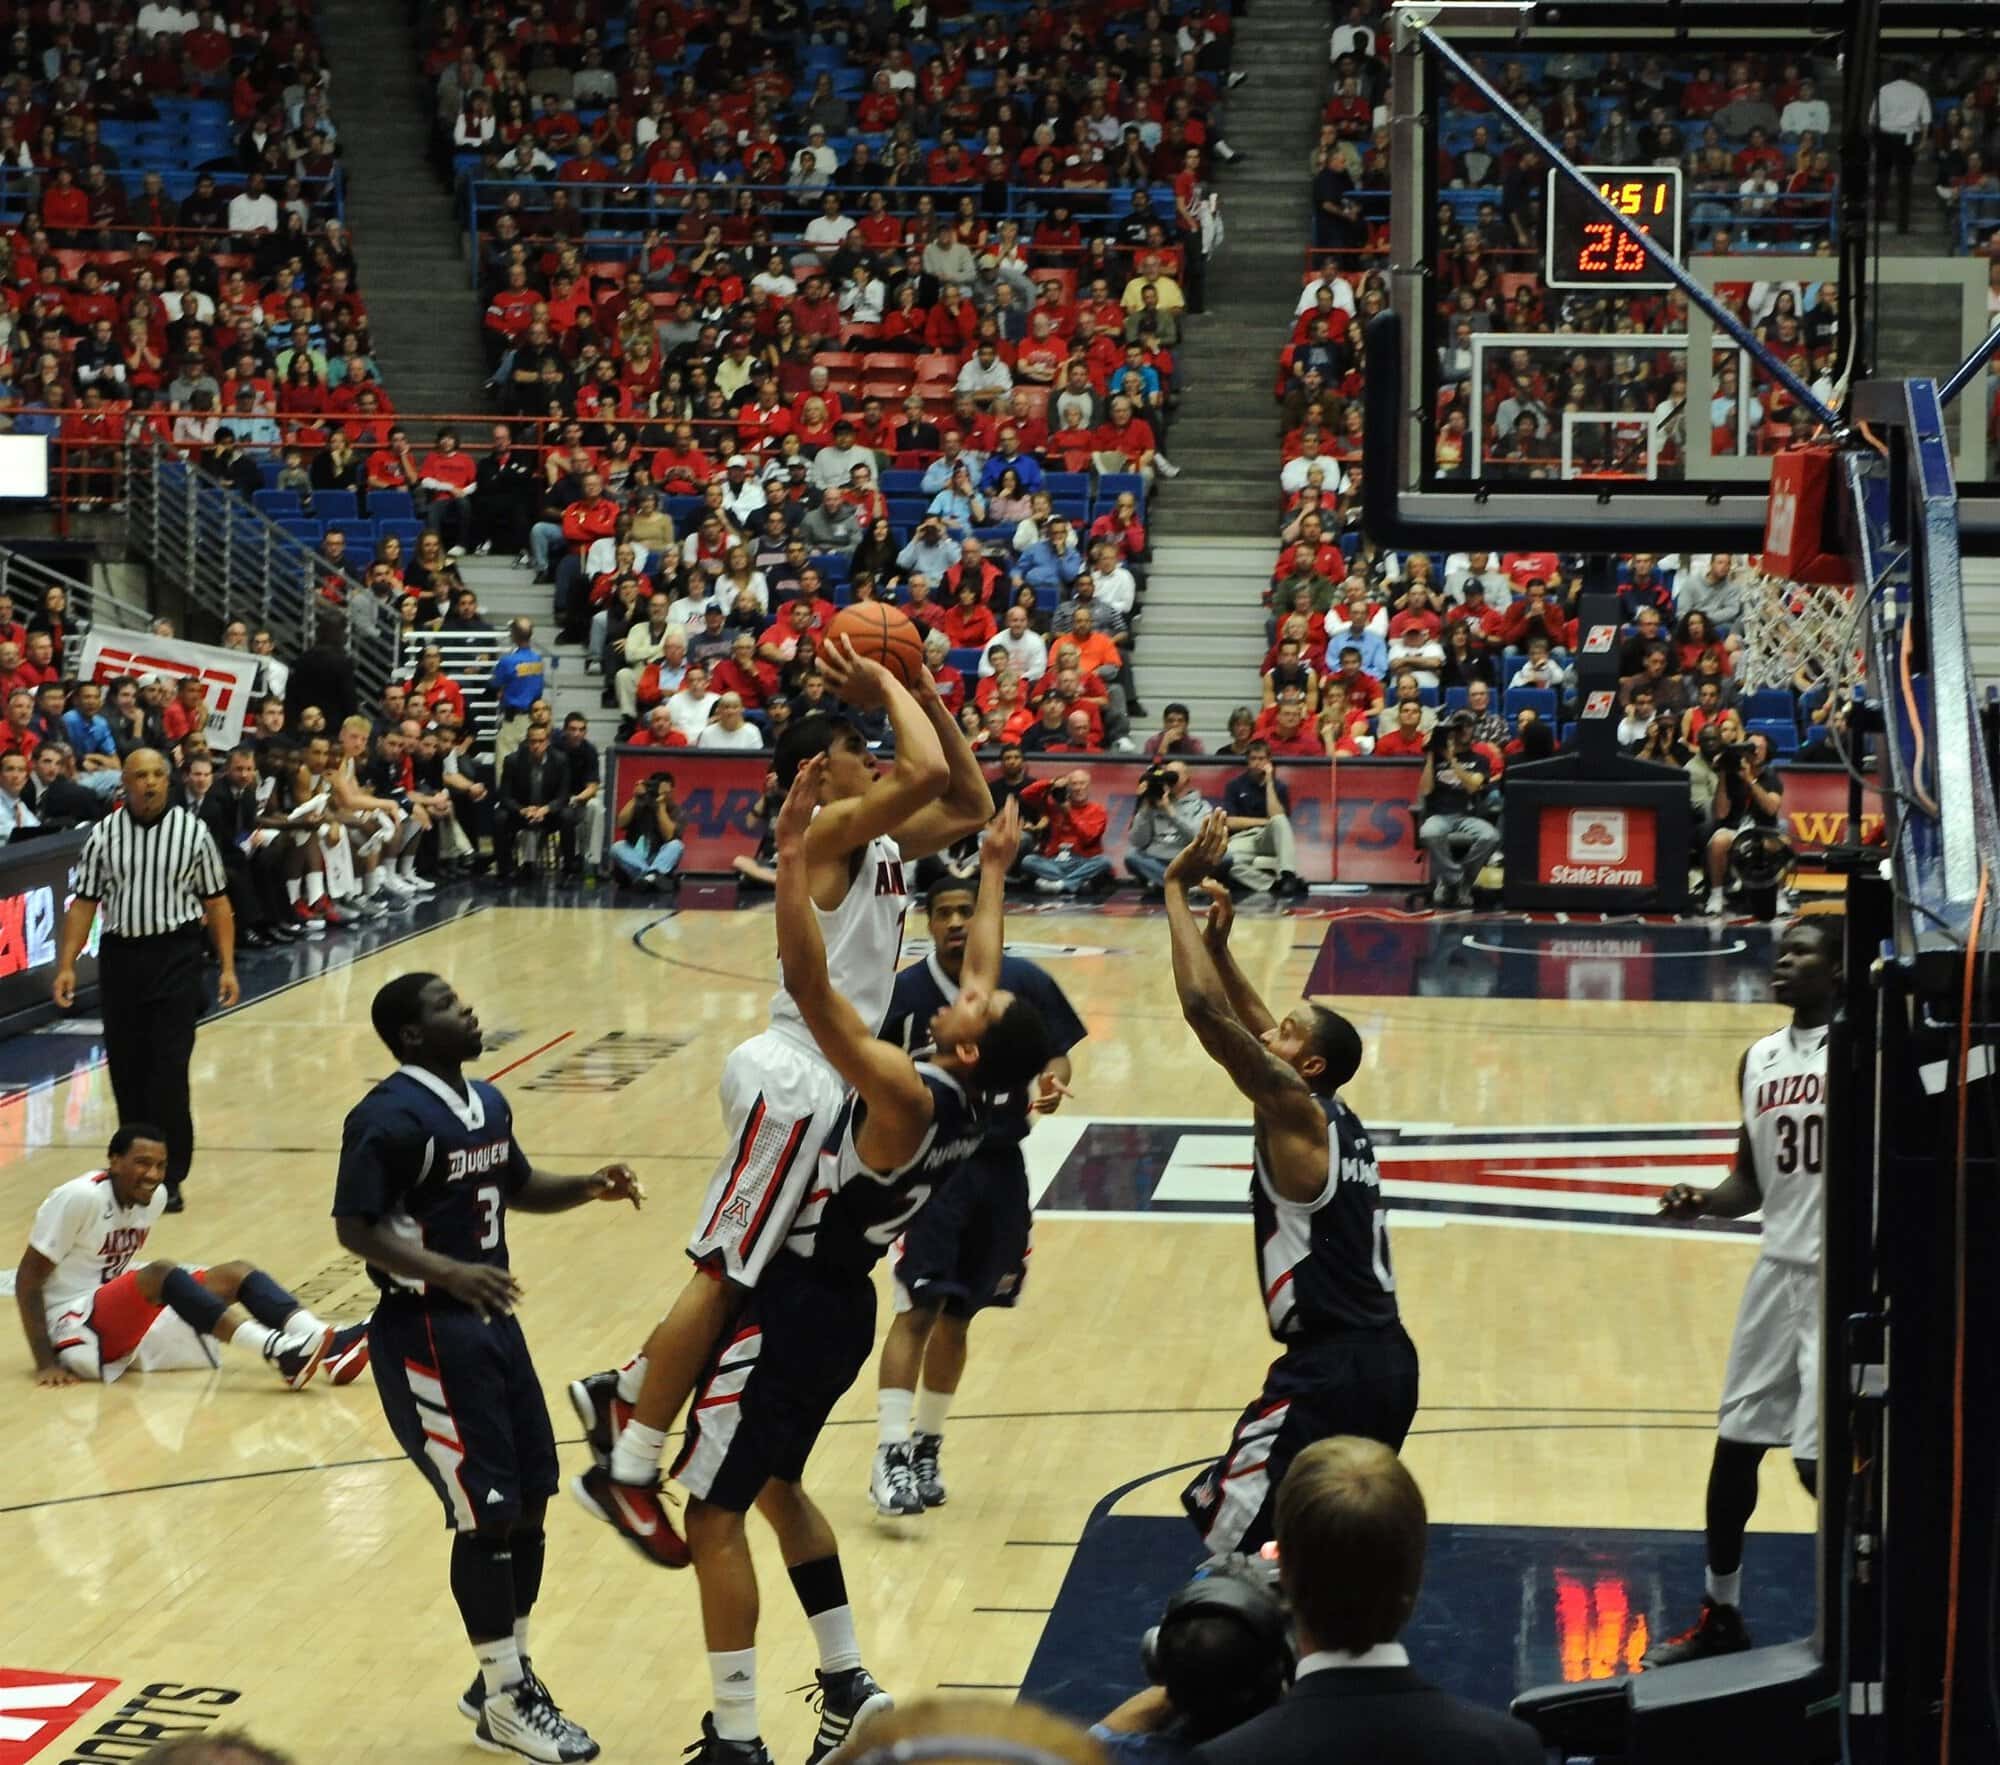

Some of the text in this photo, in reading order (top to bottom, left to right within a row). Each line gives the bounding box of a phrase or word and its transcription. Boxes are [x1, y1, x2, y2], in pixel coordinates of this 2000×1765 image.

[1579, 223, 1650, 271] 26
[1756, 1073, 1827, 1113] ARIZO
[1776, 1114, 1824, 1174] 30
[477, 1186, 501, 1251] 3
[863, 1184, 932, 1245] 2
